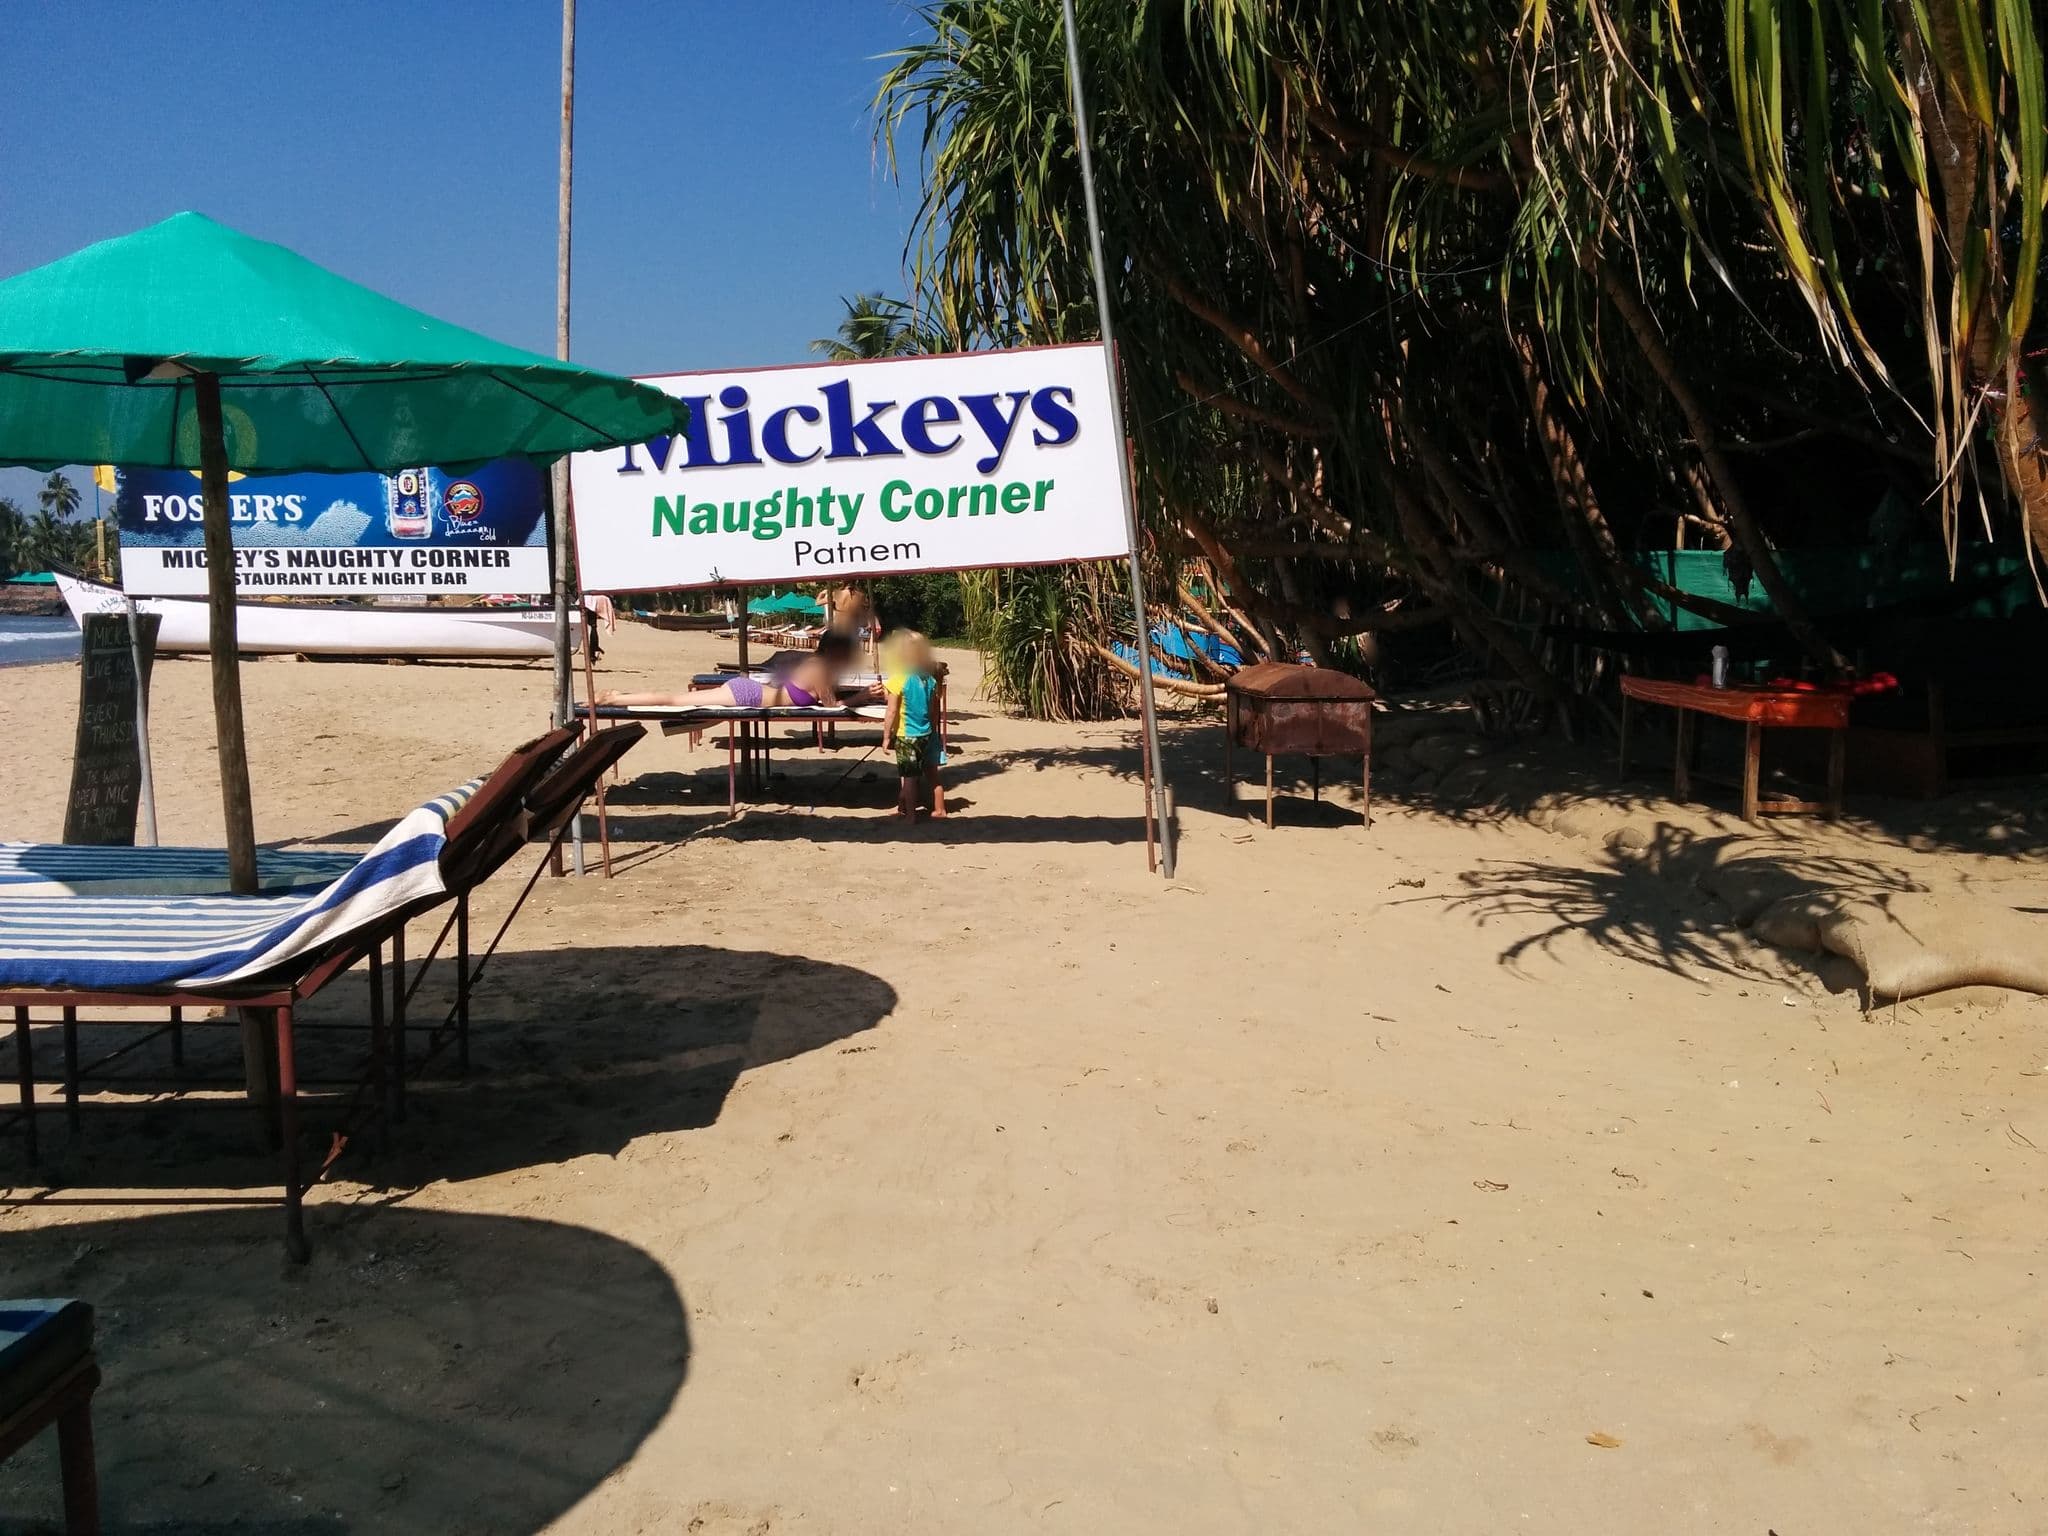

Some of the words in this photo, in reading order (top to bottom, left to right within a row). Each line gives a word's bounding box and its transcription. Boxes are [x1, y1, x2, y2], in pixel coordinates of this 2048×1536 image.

[617, 379, 1079, 475] Mickeys
[143, 494, 304, 522] FOSER'S
[651, 486, 865, 540] Naughty
[879, 479, 1055, 523] Corner
[162, 549, 281, 569] MICEY'S
[287, 549, 404, 568] NAUGHTY
[410, 549, 511, 568] CORNER
[793, 539, 922, 567] Patnem
[235, 572, 324, 586] STAURANT
[327, 572, 368, 586] LATE
[372, 572, 427, 586] NIGHT
[431, 572, 468, 586] BAR
[105, 784, 129, 804] MIC
